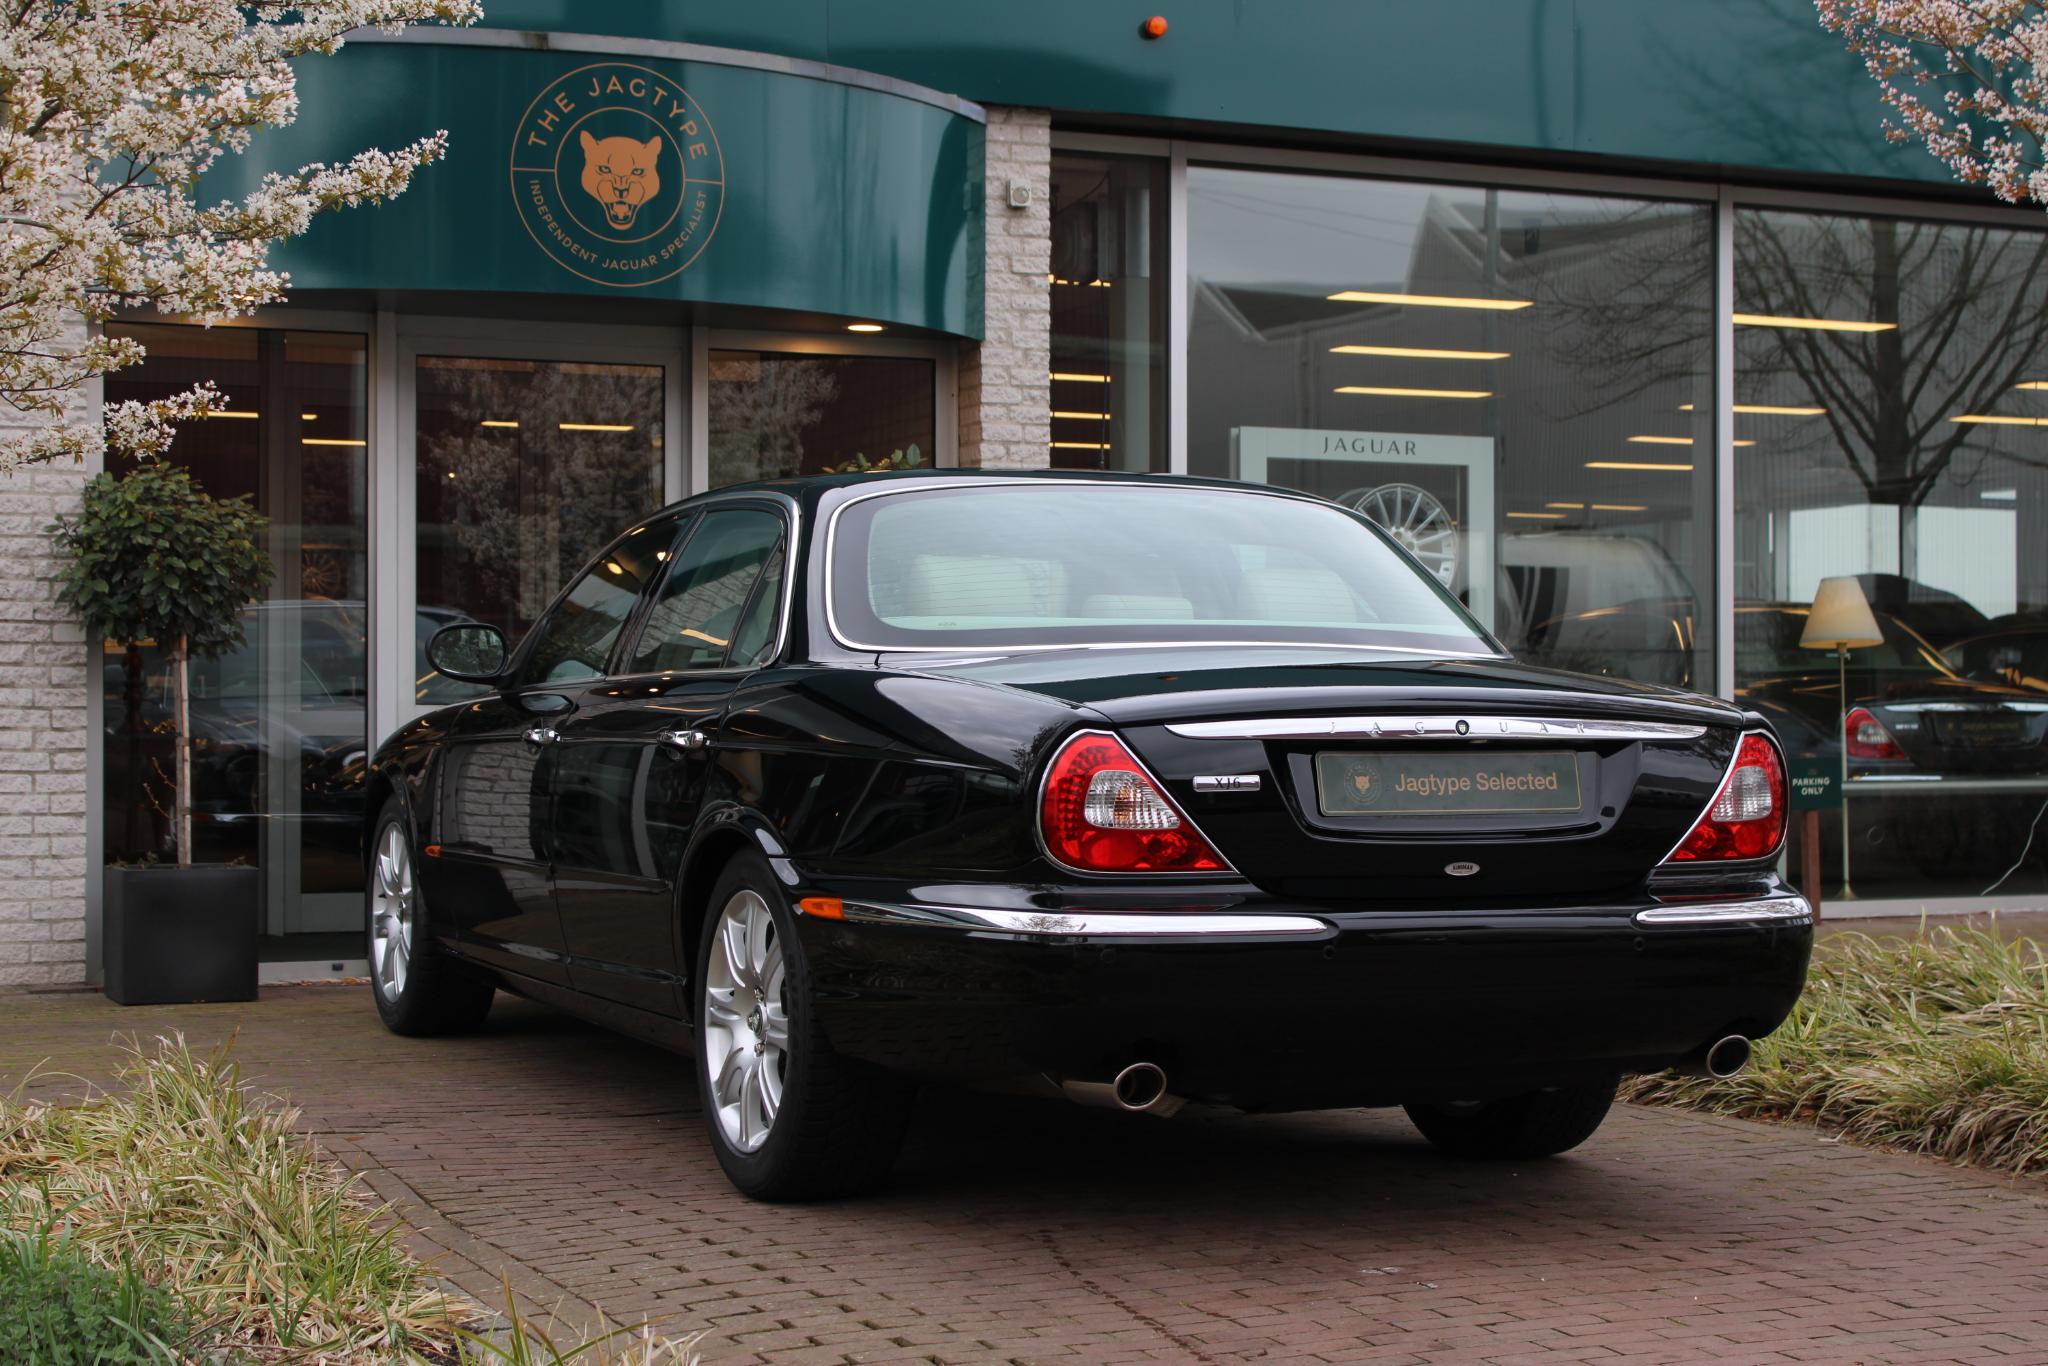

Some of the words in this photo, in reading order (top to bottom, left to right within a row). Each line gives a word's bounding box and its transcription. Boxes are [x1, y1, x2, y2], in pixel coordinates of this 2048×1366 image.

[528, 91, 575, 147] THE
[588, 75, 708, 160] JAGTYPE
[529, 179, 598, 264] INDEPENDENT
[602, 254, 658, 271] JAGUAR
[660, 191, 707, 260] SPECIALIST
[1323, 436, 1416, 456] JAGUAR
[1329, 720, 1585, 735] JAGUAR
[1214, 776, 1241, 790] XJ6
[1395, 773, 1472, 796] Jagtype
[1476, 771, 1558, 792] Selected
[1792, 777, 1830, 787] PARKING
[1801, 786, 1824, 796] ONLY
